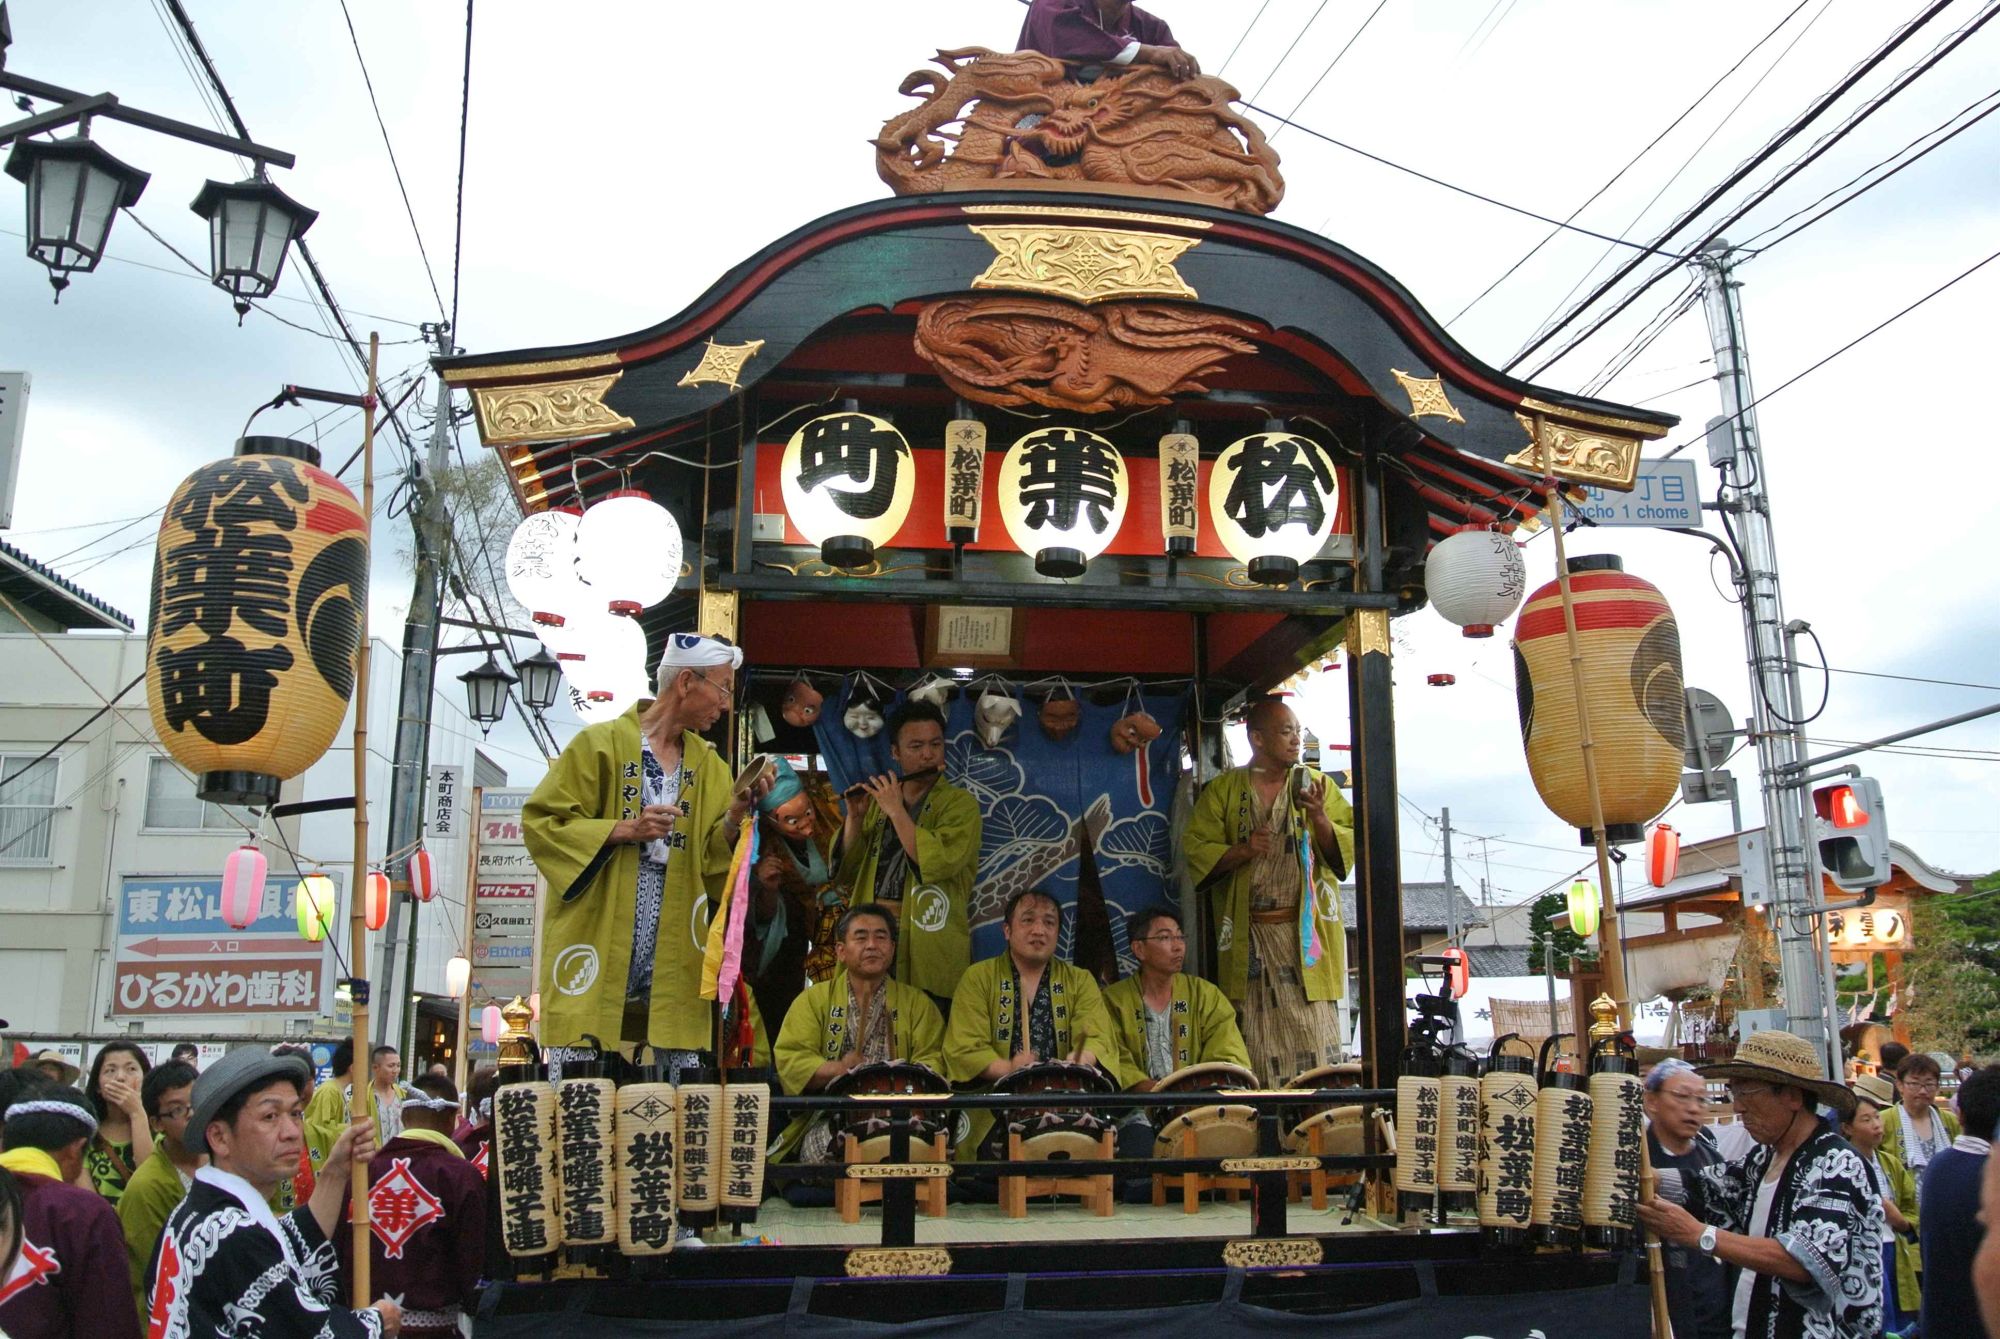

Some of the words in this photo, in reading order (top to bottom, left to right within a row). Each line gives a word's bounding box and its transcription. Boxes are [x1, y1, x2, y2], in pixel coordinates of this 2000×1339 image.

[795, 415, 909, 519] 町
[950, 444, 982, 521] 松葉町
[1019, 428, 1118, 534] 葉
[1167, 457, 1197, 530] 松葉町
[1224, 435, 1336, 539] 松
[1622, 505, 1630, 519] 1
[1637, 505, 1689, 519] chome
[156, 457, 309, 746] 松葉町
[436, 770, 455, 833] 本町商店会
[485, 822, 524, 839] タカ
[208, 940, 239, 952] 入口
[119, 969, 316, 1009] ひるかわ歯科
[625, 1130, 674, 1249] 松葉町
[1493, 1114, 1535, 1223] 松葉町
